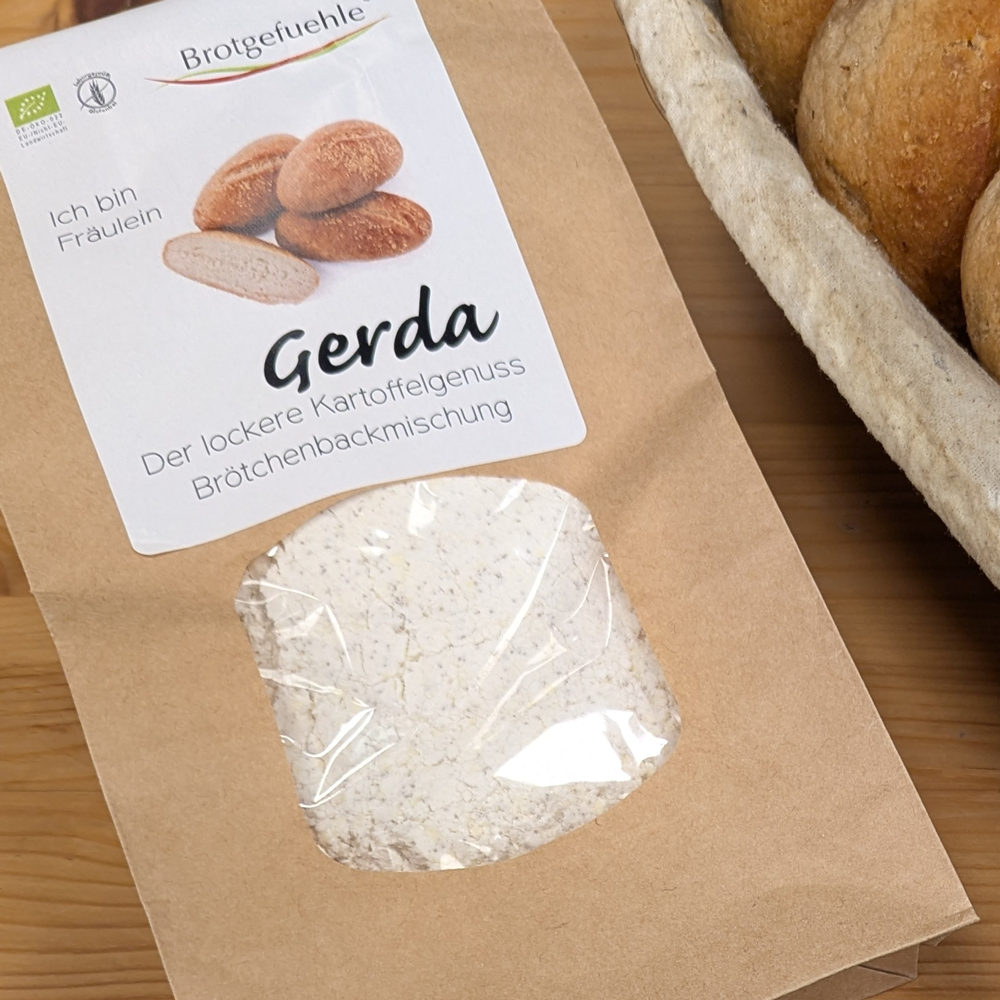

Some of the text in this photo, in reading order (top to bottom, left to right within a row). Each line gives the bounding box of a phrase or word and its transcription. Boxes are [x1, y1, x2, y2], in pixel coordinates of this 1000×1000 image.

[180, 4, 366, 71] Brotgefuehle
[49, 188, 138, 228] Ich bin
[57, 207, 162, 252] Fräulein
[263, 284, 500, 393] Gerda
[141, 356, 526, 476] Der lockere Kartoffelgenuss
[191, 398, 513, 501] Brötchenbackmischung
